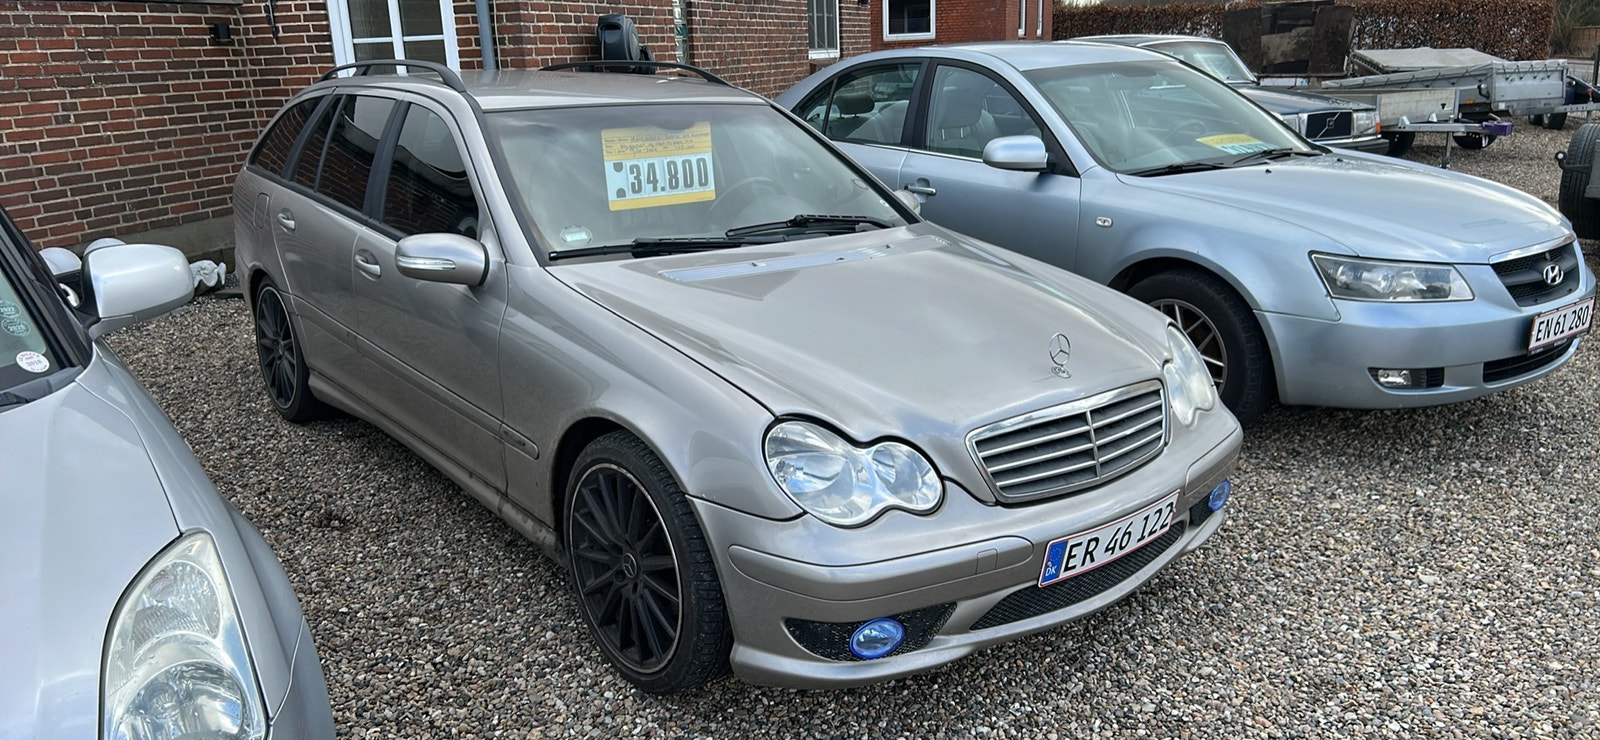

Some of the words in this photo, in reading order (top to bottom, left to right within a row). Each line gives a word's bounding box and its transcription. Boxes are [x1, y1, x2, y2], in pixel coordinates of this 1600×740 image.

[629, 157, 708, 193] 34.800
[1535, 318, 1553, 342] EN
[1553, 312, 1567, 336] 61
[1568, 305, 1589, 331] 280
[1063, 536, 1099, 572] ER
[1104, 521, 1133, 555] 46
[1137, 502, 1174, 542] 122
[1045, 565, 1057, 576] DK
